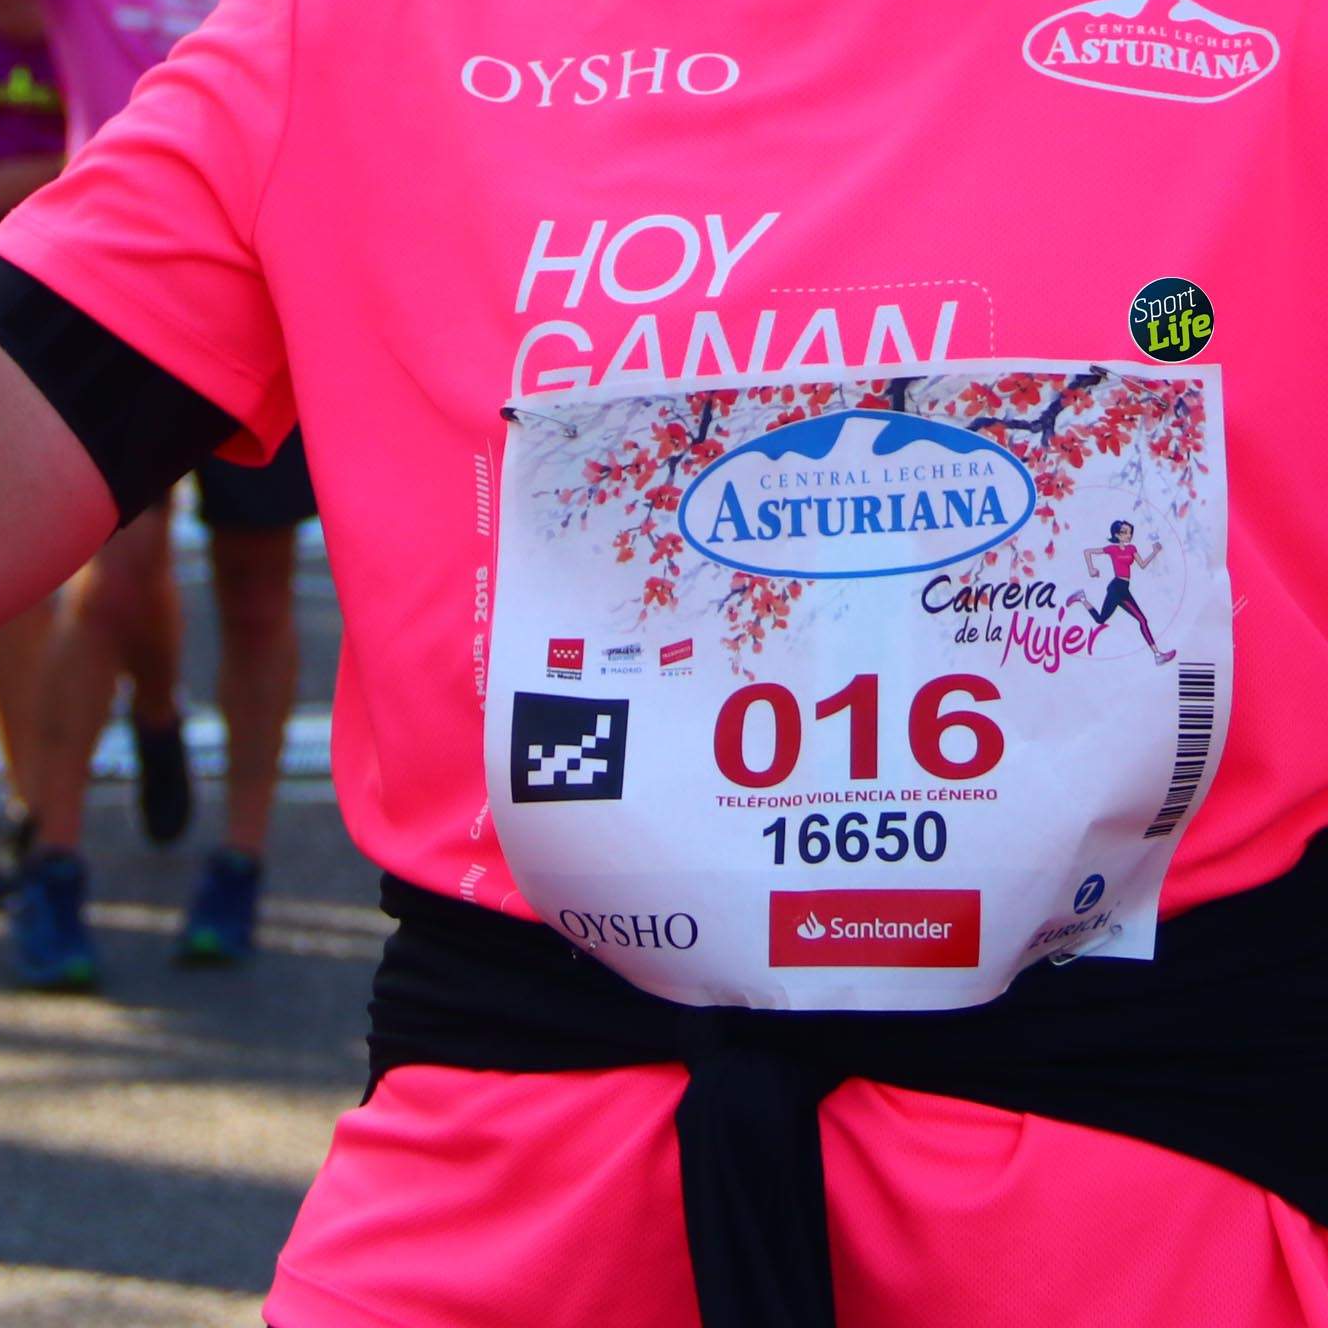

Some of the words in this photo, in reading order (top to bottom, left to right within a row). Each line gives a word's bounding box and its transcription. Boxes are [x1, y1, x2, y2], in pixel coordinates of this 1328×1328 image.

[1043, 27, 1261, 80] ASTURIANA
[1084, 23, 1168, 38] CENTRAL
[1174, 29, 1253, 49] LECHERA
[461, 46, 740, 108] OYSHO
[514, 212, 780, 313] HOY
[1134, 286, 1196, 323] Sport
[1147, 309, 1212, 352] Life
[511, 300, 959, 400] GANAN
[760, 468, 870, 490] CENTRAL
[883, 461, 995, 483] LECHERA
[706, 480, 1009, 544] ASTURIANA
[474, 566, 489, 624] 2018
[920, 574, 1058, 616] Carrera
[954, 615, 980, 644] de
[985, 615, 1003, 643] la
[1000, 597, 1111, 673] Mujer
[474, 633, 489, 696] MUJER
[713, 672, 1005, 789] 016
[715, 793, 803, 809] TELÉFONO
[806, 789, 896, 805] VIOLENCIA
[901, 789, 922, 802] DE
[927, 786, 999, 802] GÉNERO
[762, 810, 948, 865] 16650
[559, 908, 699, 950] OYSHO
[830, 917, 953, 940] Santander
[1028, 910, 1113, 950] ZURICH
